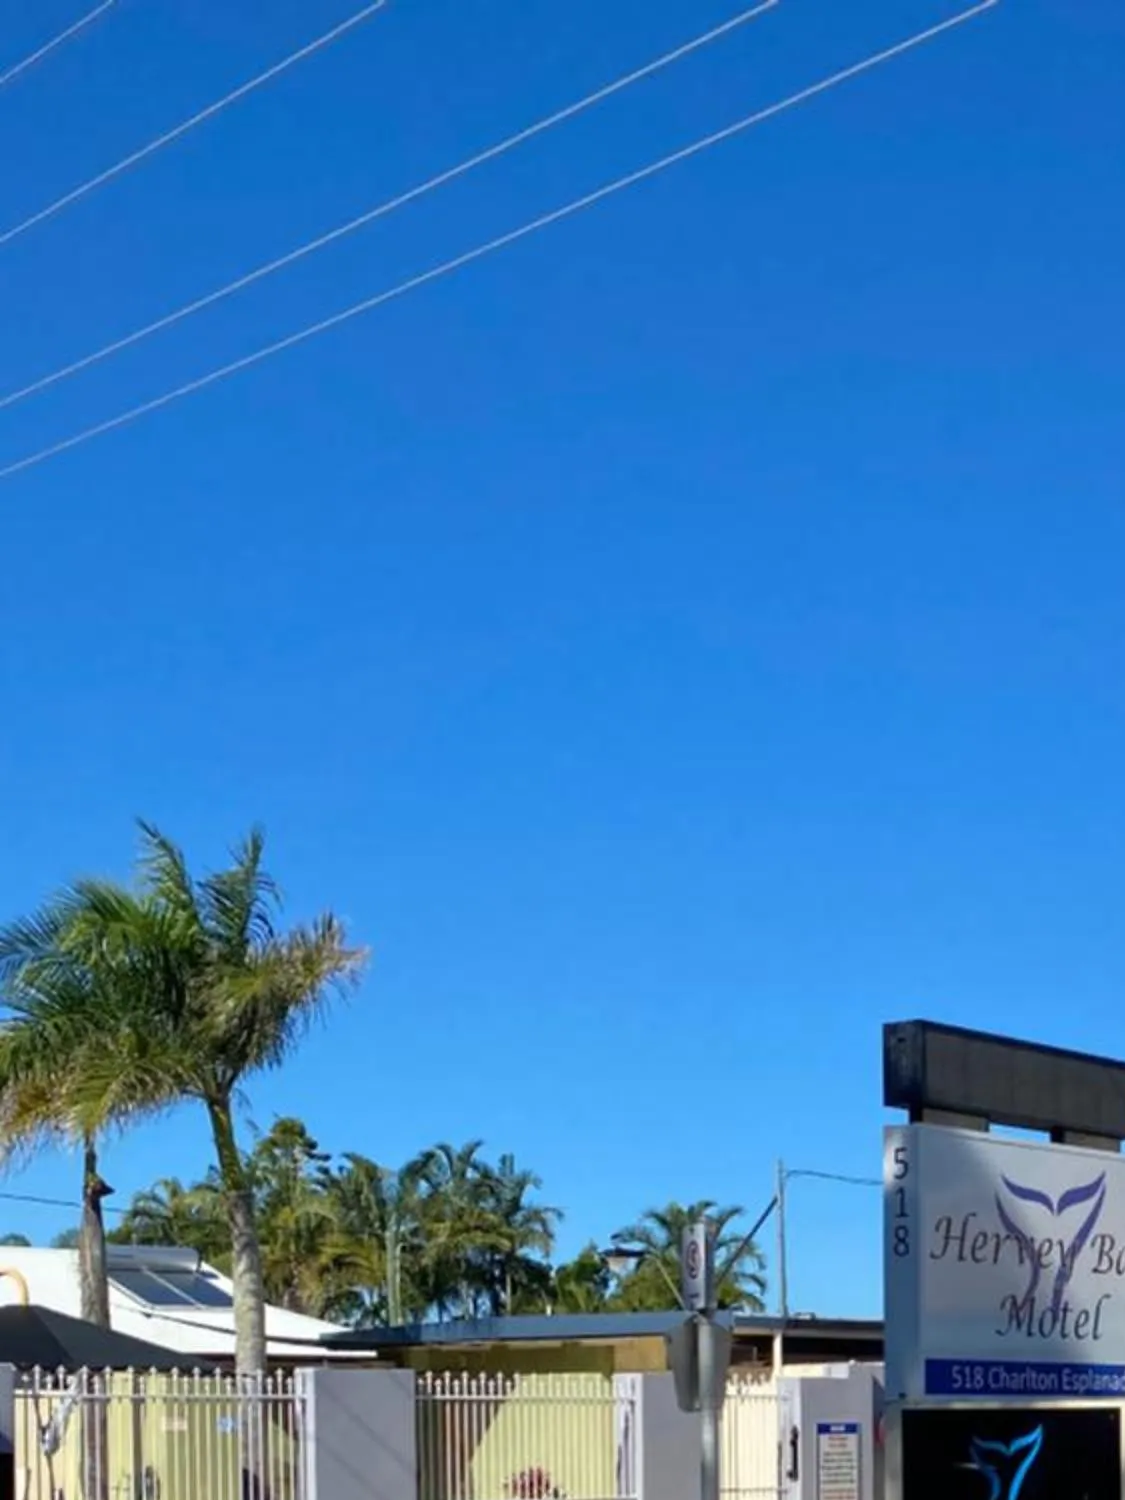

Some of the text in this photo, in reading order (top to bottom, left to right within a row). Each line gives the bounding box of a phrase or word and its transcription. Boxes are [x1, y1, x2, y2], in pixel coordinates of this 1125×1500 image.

[892, 1146, 911, 1258] 518
[929, 1212, 1078, 1278] Hervey
[995, 1293, 1112, 1341] Motel
[951, 1365, 985, 1389] 518
[987, 1367, 1059, 1391] Charlton
